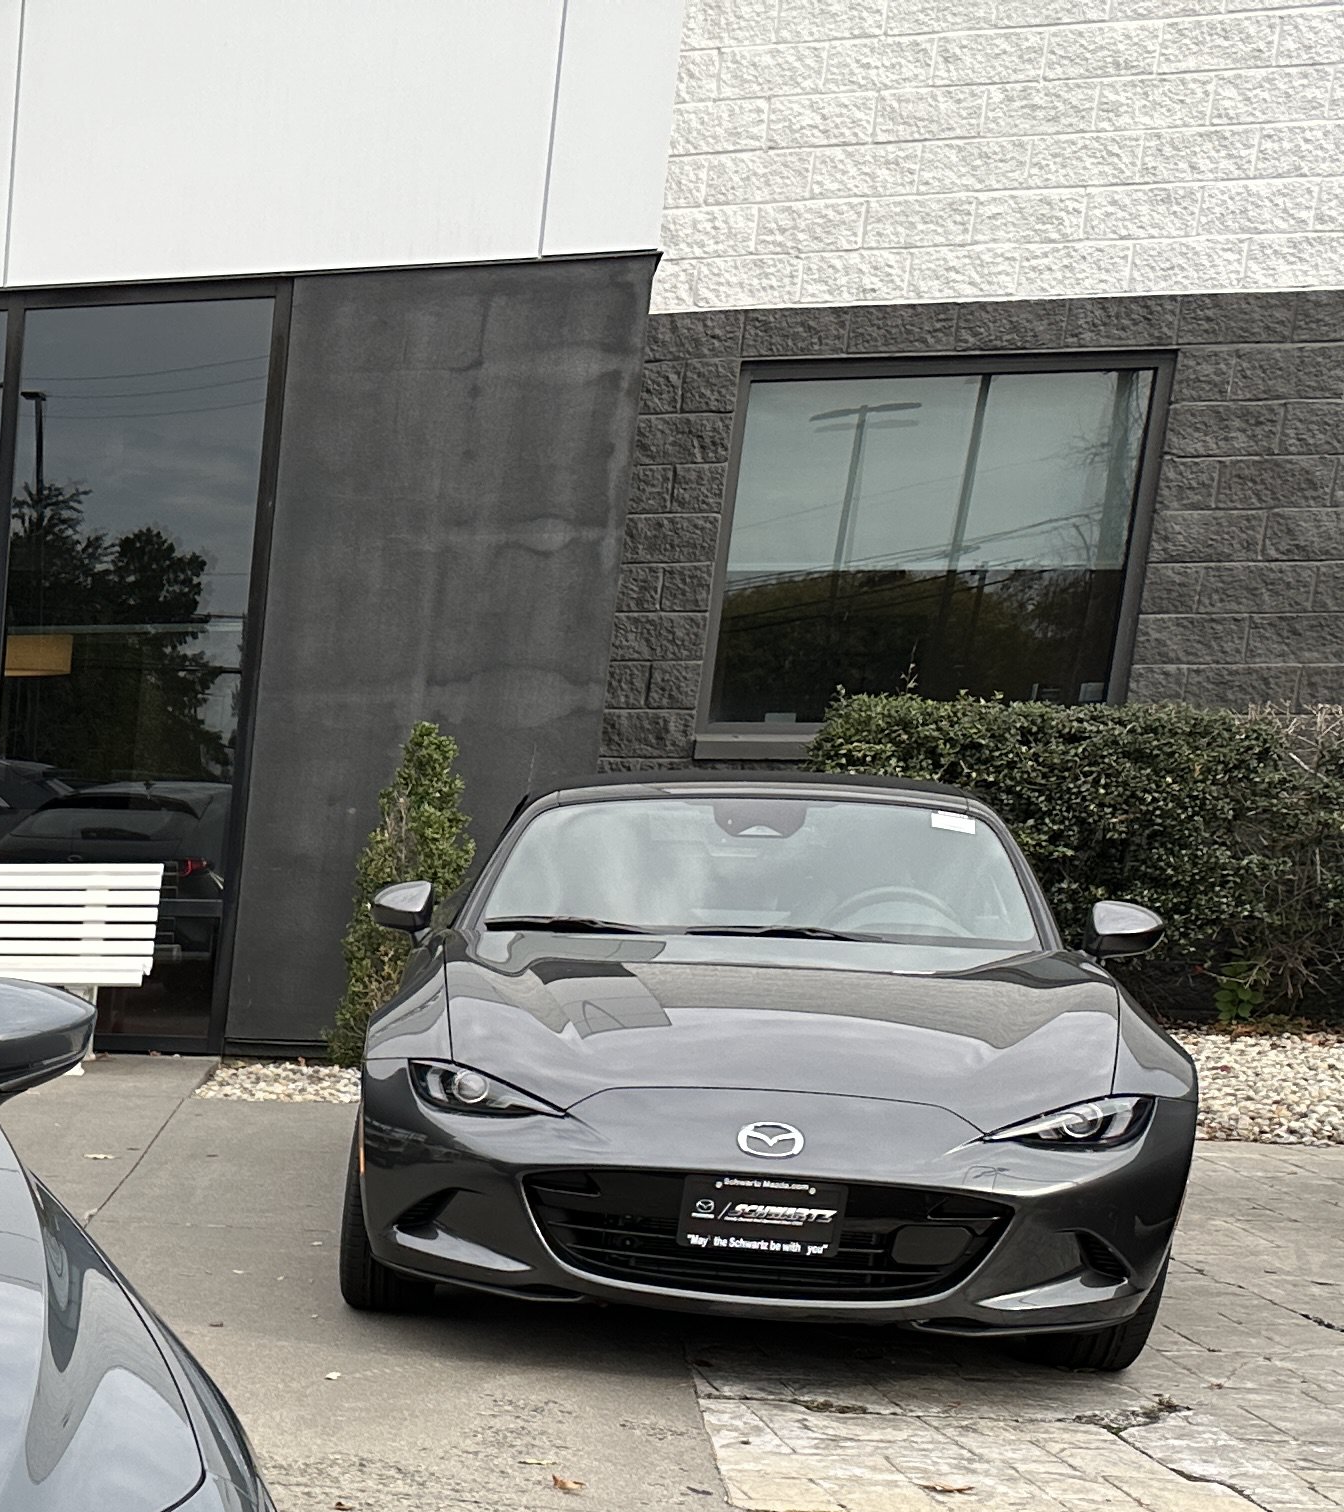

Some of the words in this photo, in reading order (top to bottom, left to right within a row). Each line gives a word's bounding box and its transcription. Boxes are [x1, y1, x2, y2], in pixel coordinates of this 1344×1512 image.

[727, 1203, 838, 1224] SCHWARTZ
[713, 1235, 728, 1247] the
[728, 1237, 769, 1251] Schwartz
[770, 1240, 782, 1251] be
[782, 1241, 802, 1253] with
